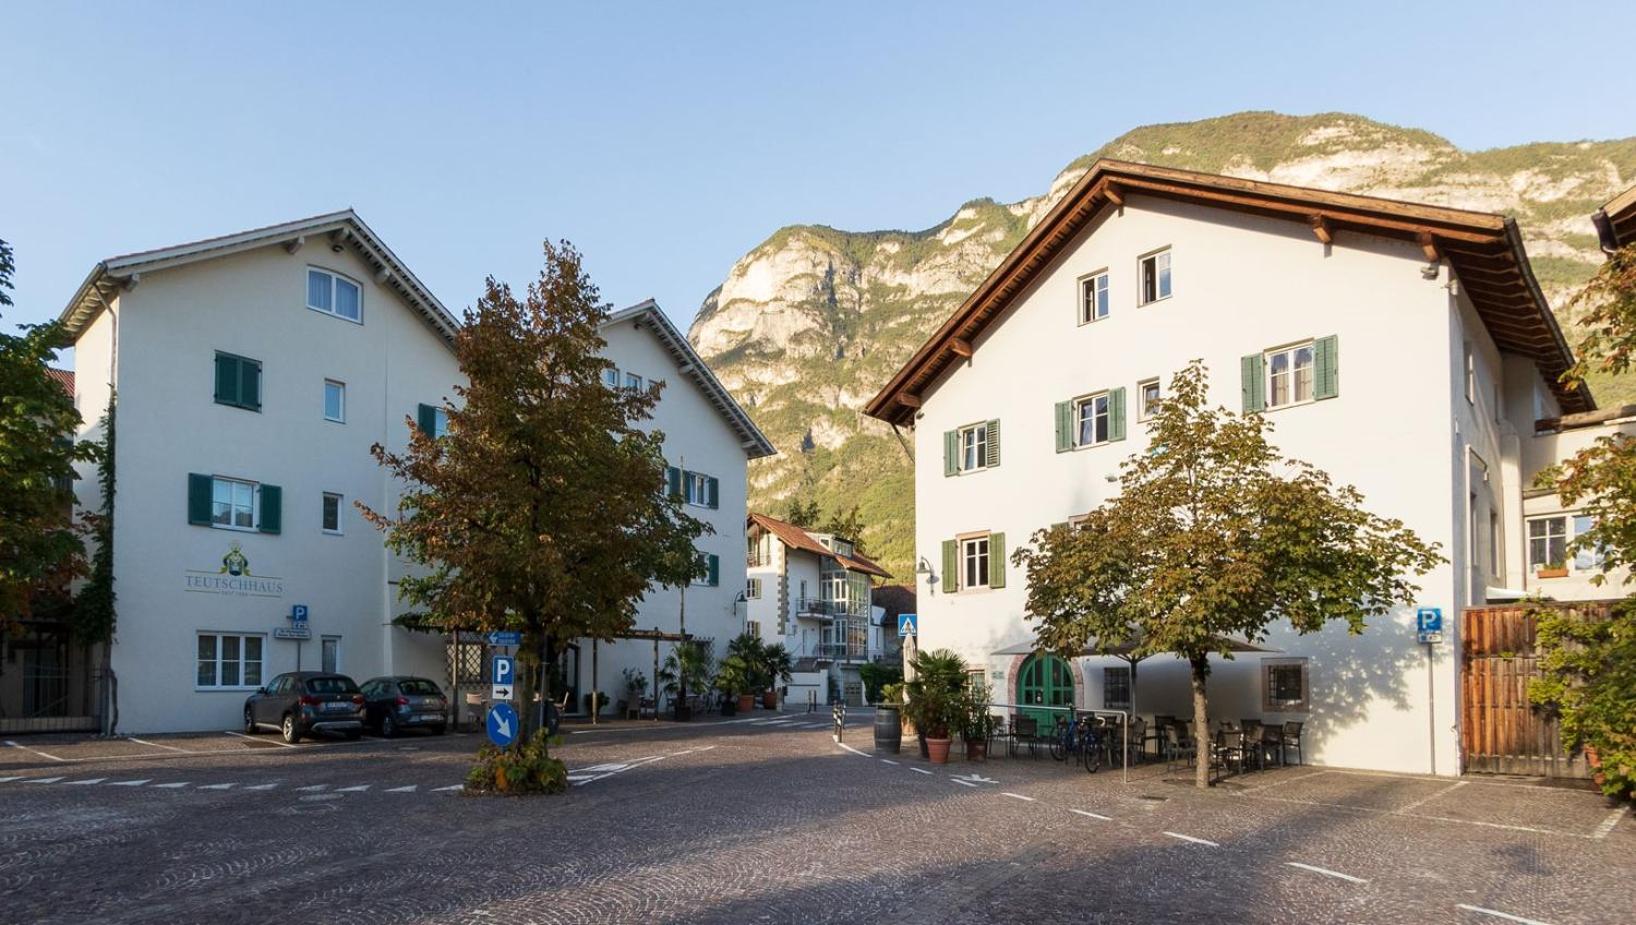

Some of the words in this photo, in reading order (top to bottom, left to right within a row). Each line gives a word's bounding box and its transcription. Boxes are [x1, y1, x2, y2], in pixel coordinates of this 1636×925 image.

[185, 575, 283, 593] TEUTSCHHAUS
[296, 606, 305, 620] P
[1421, 610, 1437, 629] P
[497, 659, 510, 682] P
